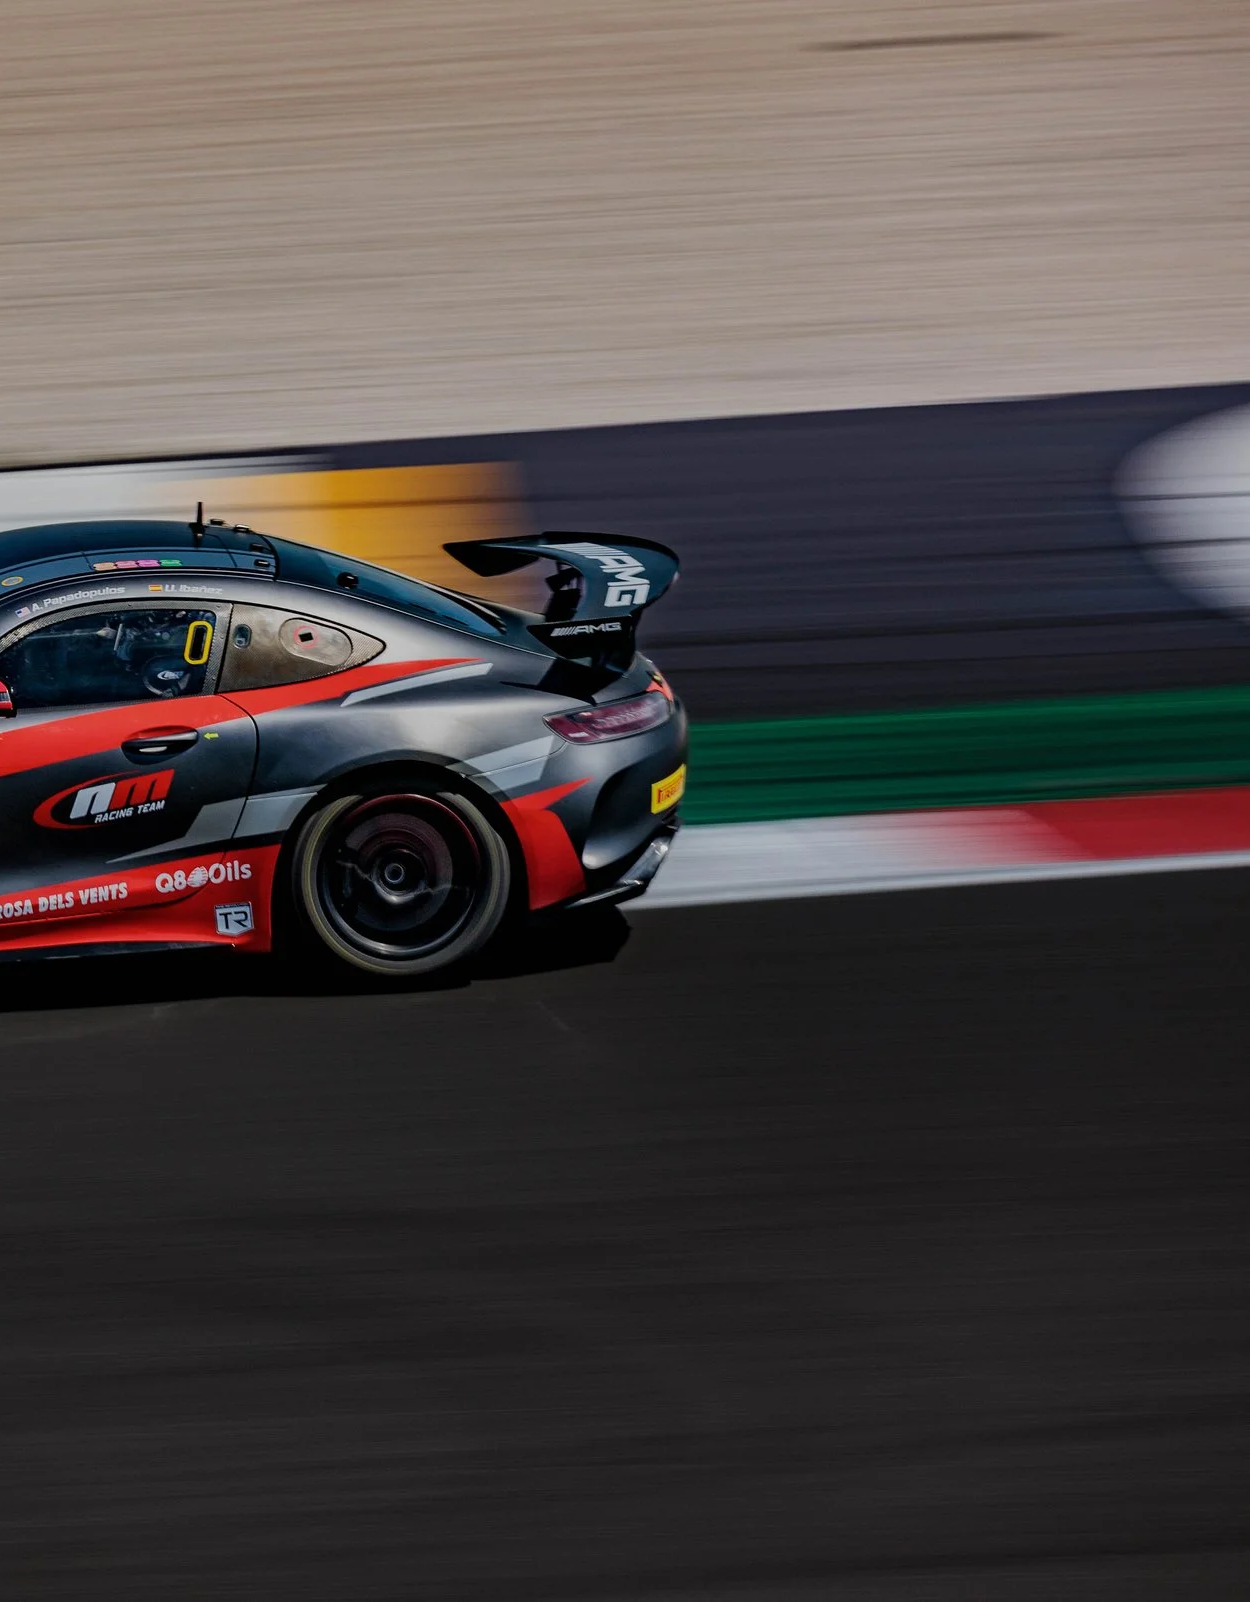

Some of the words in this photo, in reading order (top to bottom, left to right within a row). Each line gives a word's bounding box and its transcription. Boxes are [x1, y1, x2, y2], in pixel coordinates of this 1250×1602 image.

[573, 621, 622, 634] AMG
[94, 806, 134, 824] RACING
[137, 799, 166, 814] TEAM
[155, 869, 188, 894] Q8
[209, 860, 252, 884] Oils
[38, 891, 75, 912] DELS
[78, 882, 128, 905] VENTS
[219, 910, 248, 930] TR
